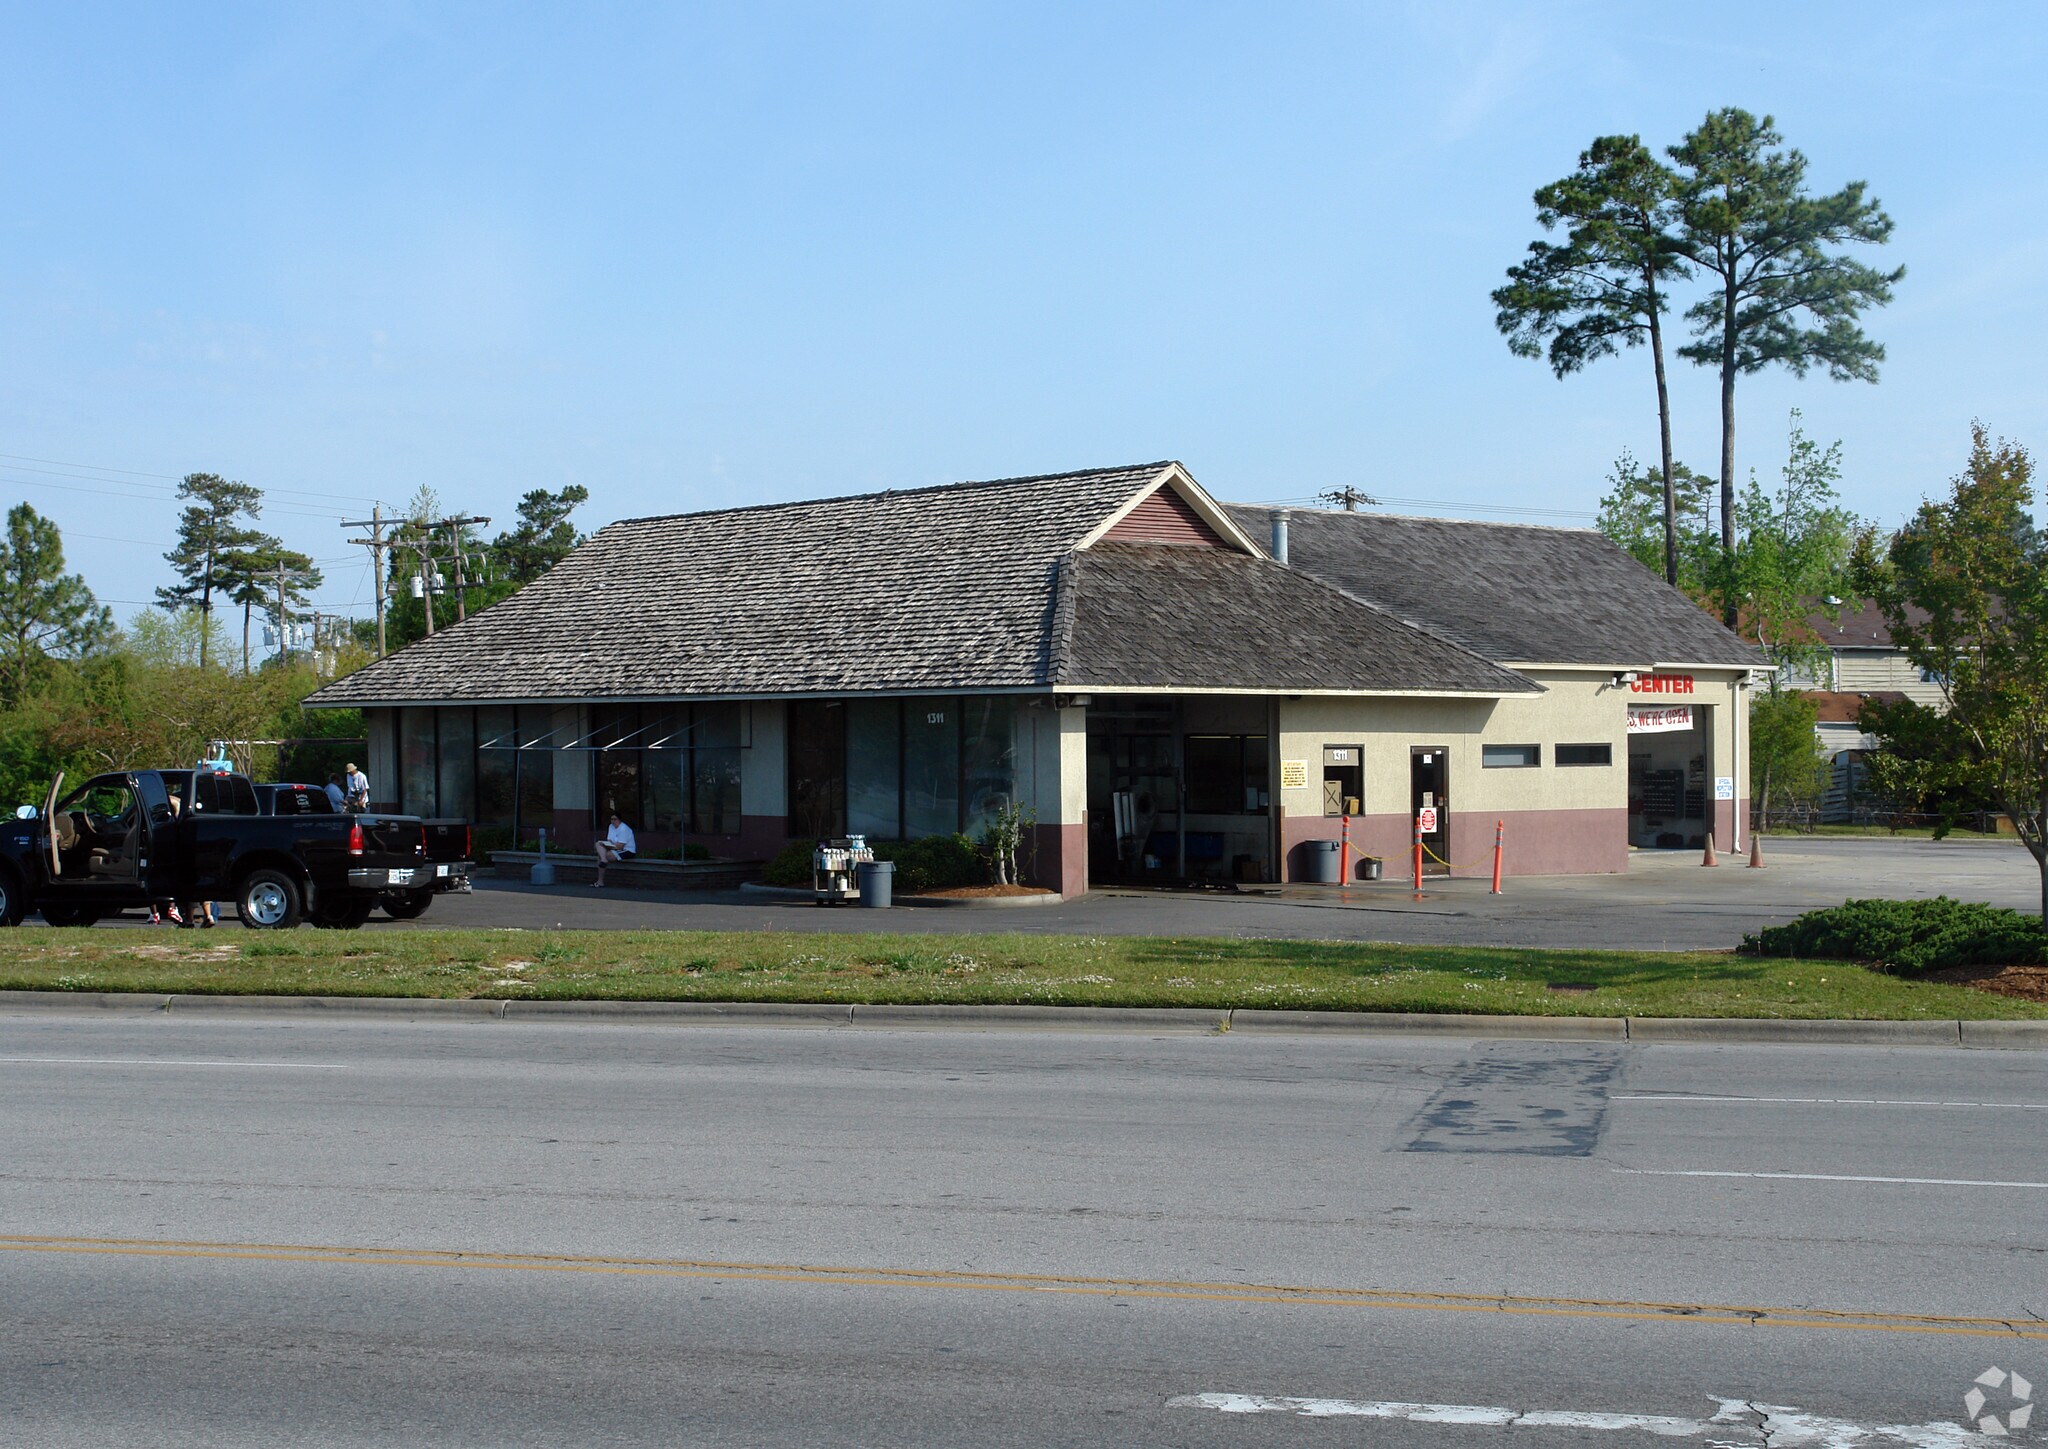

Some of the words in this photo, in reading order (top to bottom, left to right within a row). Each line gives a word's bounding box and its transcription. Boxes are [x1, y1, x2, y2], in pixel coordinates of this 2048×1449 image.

[1631, 674, 1694, 694] CENTER
[927, 712, 944, 724] 1311
[1627, 711, 1637, 727] S,
[1638, 709, 1663, 727] WE'RE
[1666, 706, 1690, 724] OPEN
[1333, 749, 1348, 761] 1311
